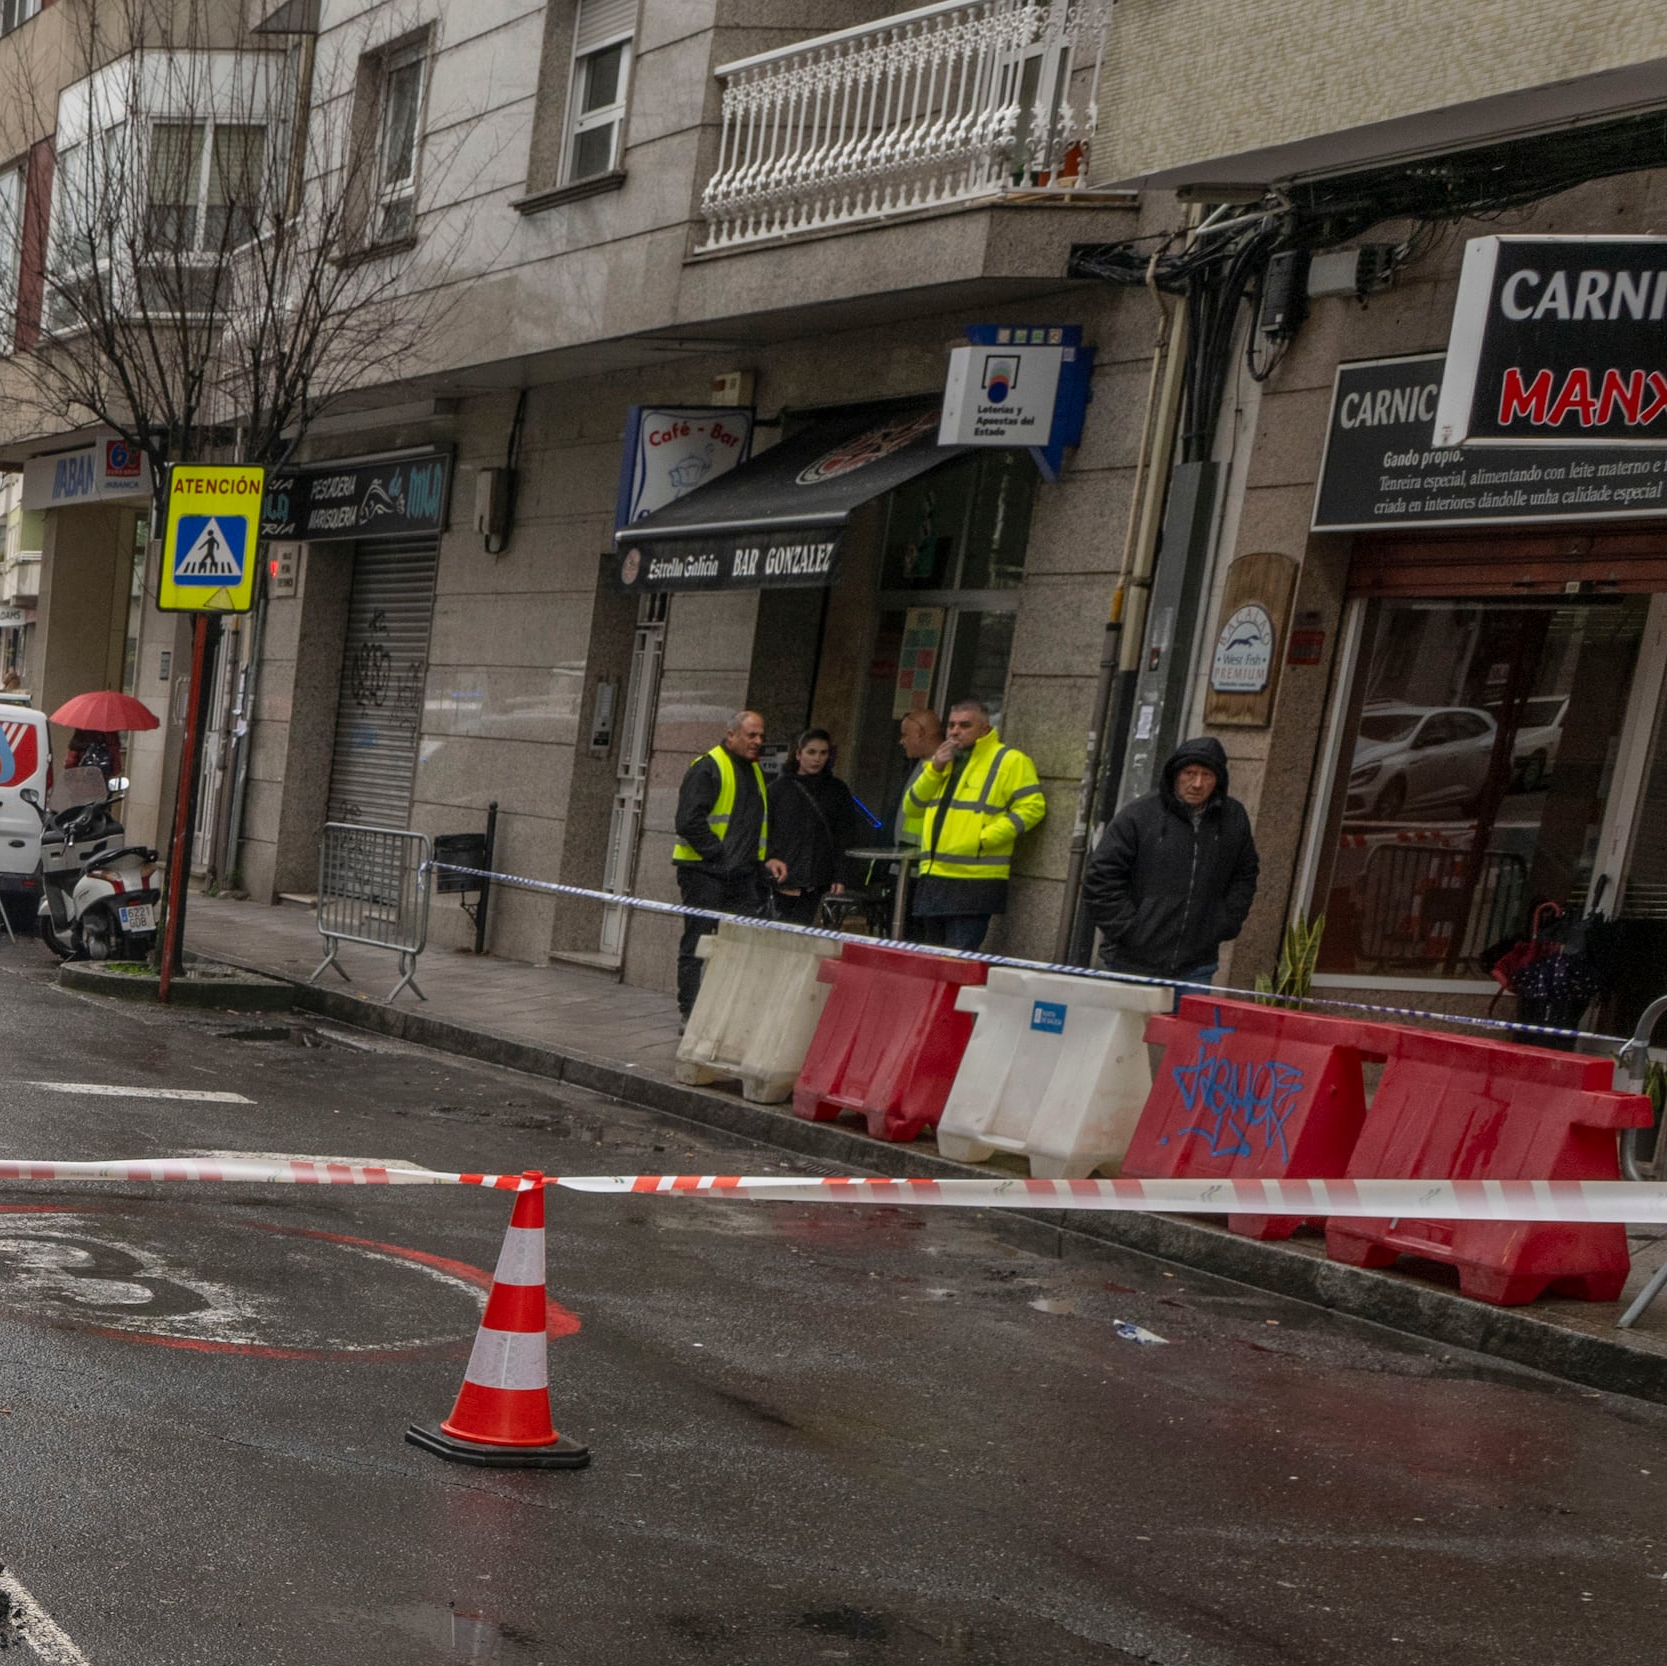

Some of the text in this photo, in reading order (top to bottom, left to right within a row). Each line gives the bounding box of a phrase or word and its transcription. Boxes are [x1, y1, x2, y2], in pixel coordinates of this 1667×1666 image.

[1016, 406, 1023, 416] y
[1339, 383, 1438, 429] CARNIC
[975, 416, 1035, 427] Apuestas del
[649, 420, 691, 447] Café
[709, 423, 740, 448] Bar
[974, 427, 1006, 437] Estado
[1383, 448, 1465, 470] Gando propio.
[173, 475, 261, 495] ATENCIÓN
[1378, 475, 1421, 492] Tenreira
[1423, 470, 1467, 492] especial,
[1469, 466, 1542, 487] alimentando
[1543, 464, 1566, 481] con
[1568, 462, 1594, 479] leite
[1596, 459, 1651, 478] materno
[1652, 461, 1661, 473] e
[1373, 480, 1663, 515] criada en interiores dándolle unha calidade especial
[647, 542, 835, 580] Estrella Galicia BAR GONZALEZ
[1222, 653, 1244, 666] West
[1214, 666, 1266, 680] PREMIUM
[129, 917, 147, 929] GDB
